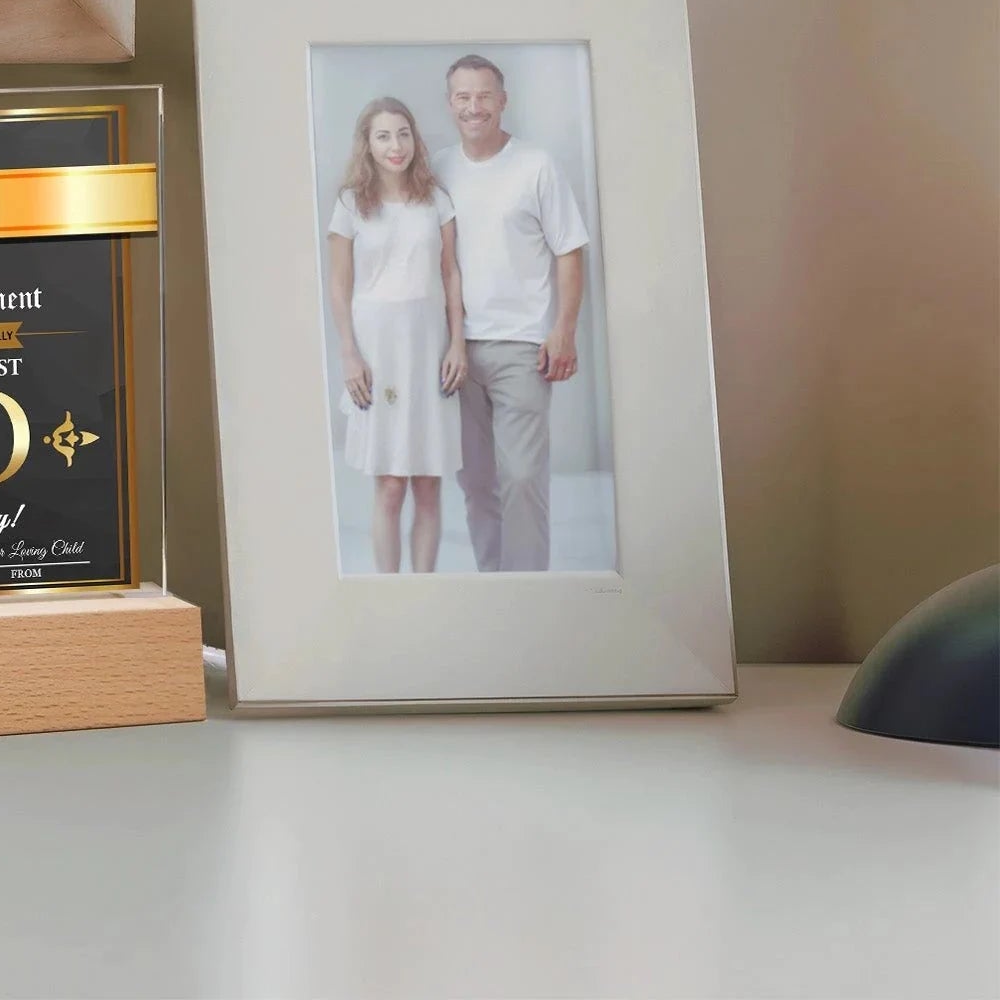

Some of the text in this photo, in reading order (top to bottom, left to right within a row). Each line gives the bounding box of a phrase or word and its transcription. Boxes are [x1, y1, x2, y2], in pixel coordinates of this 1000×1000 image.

[9, 540, 48, 562] Loving
[51, 539, 85, 556] Child
[10, 567, 42, 580] FROM
